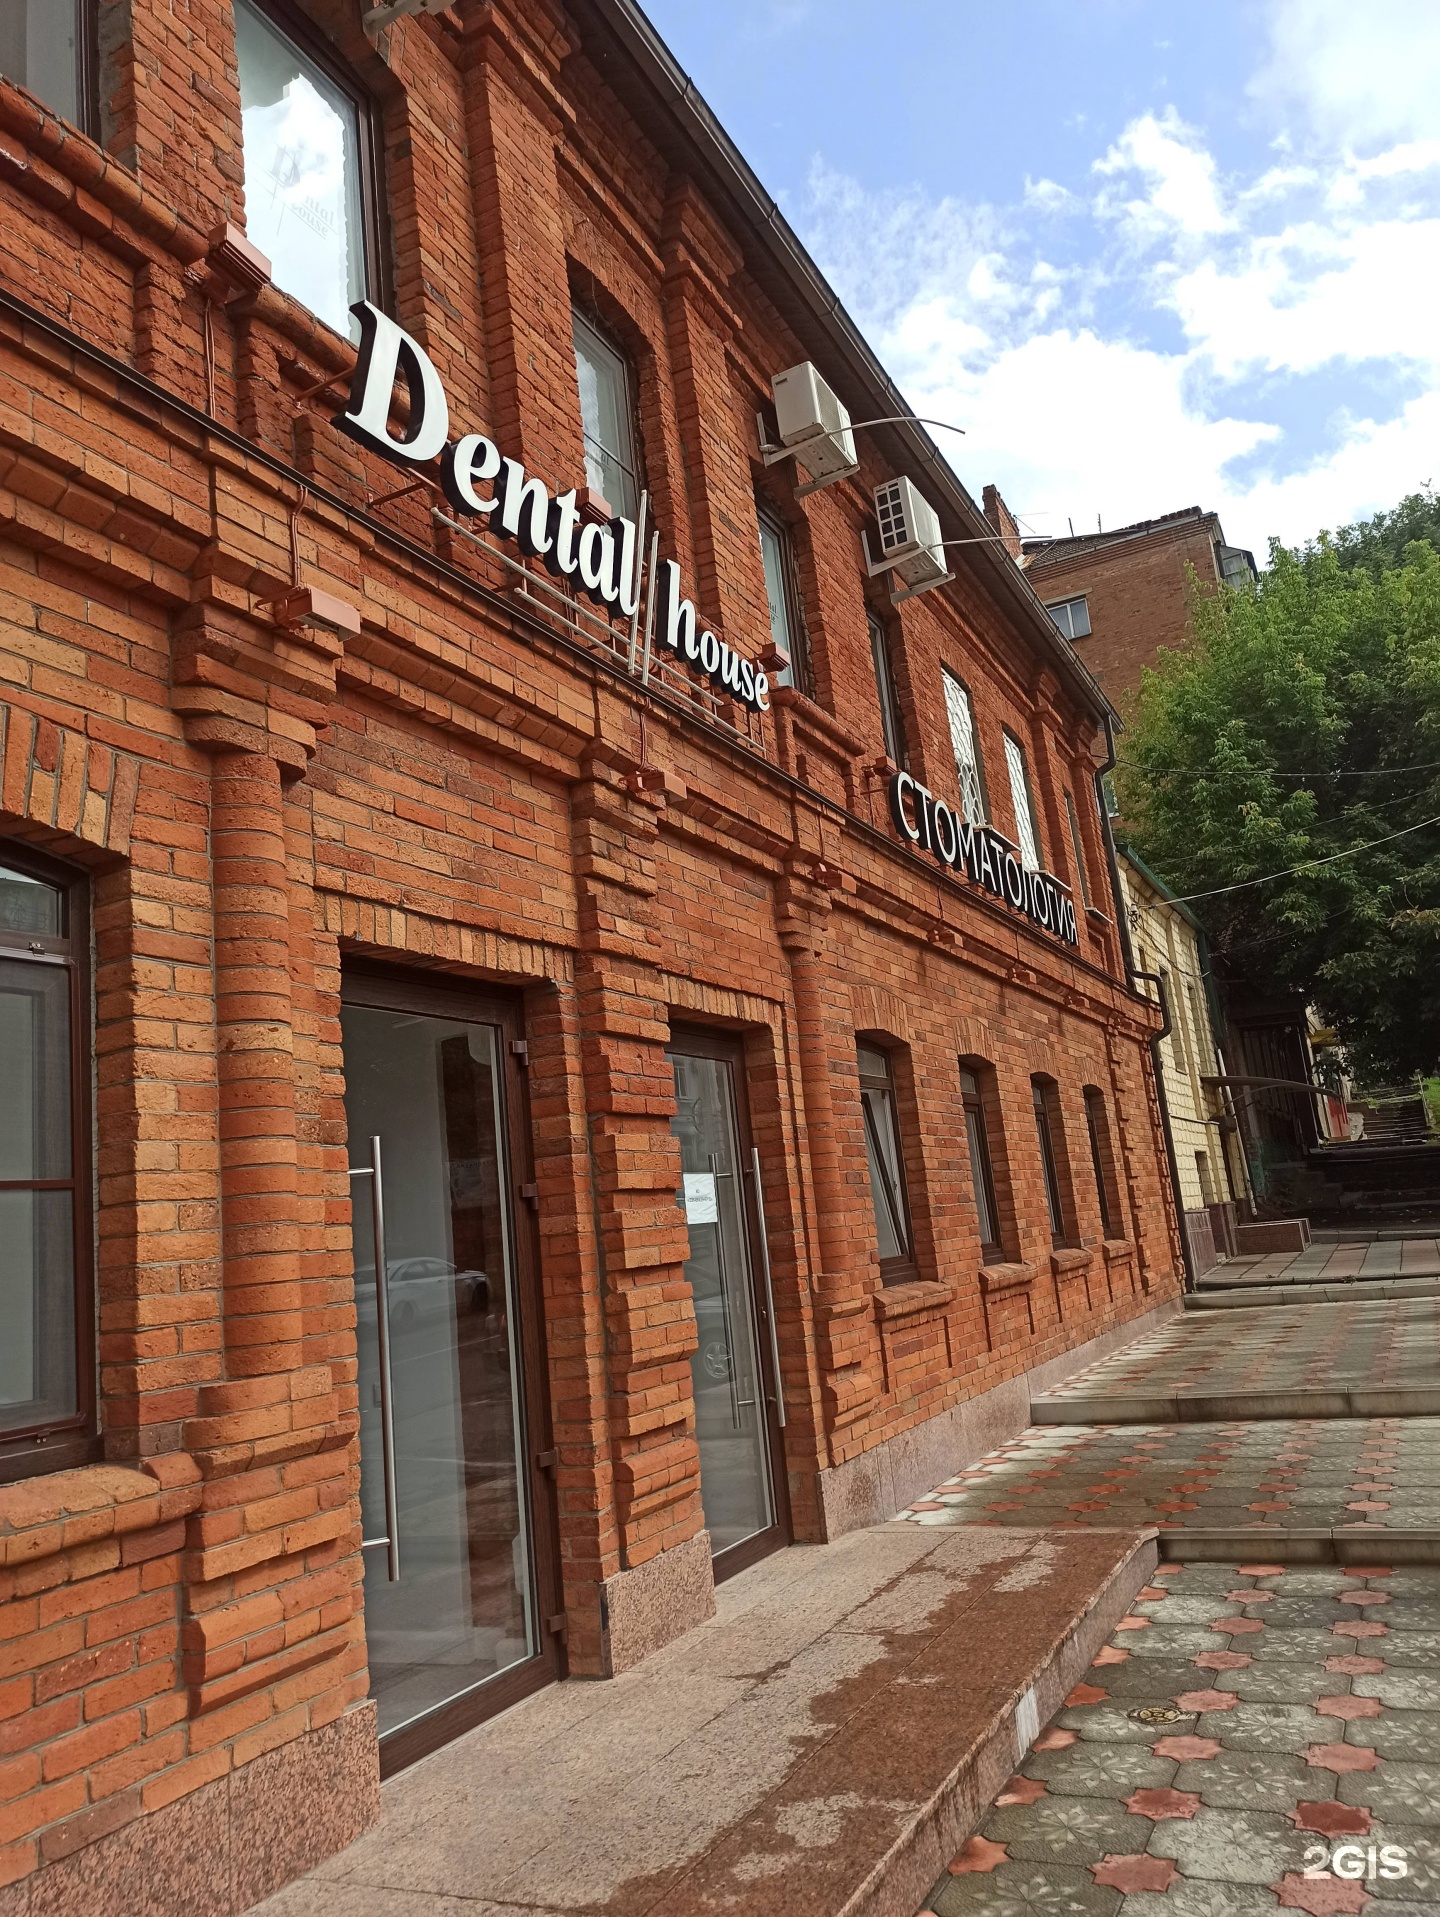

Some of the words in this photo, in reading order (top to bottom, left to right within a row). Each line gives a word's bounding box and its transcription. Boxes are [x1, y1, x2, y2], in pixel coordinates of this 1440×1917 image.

[335, 299, 638, 617] Dental
[660, 558, 771, 712] house
[891, 771, 1079, 947] СТОМАТОЛОГИЯ
